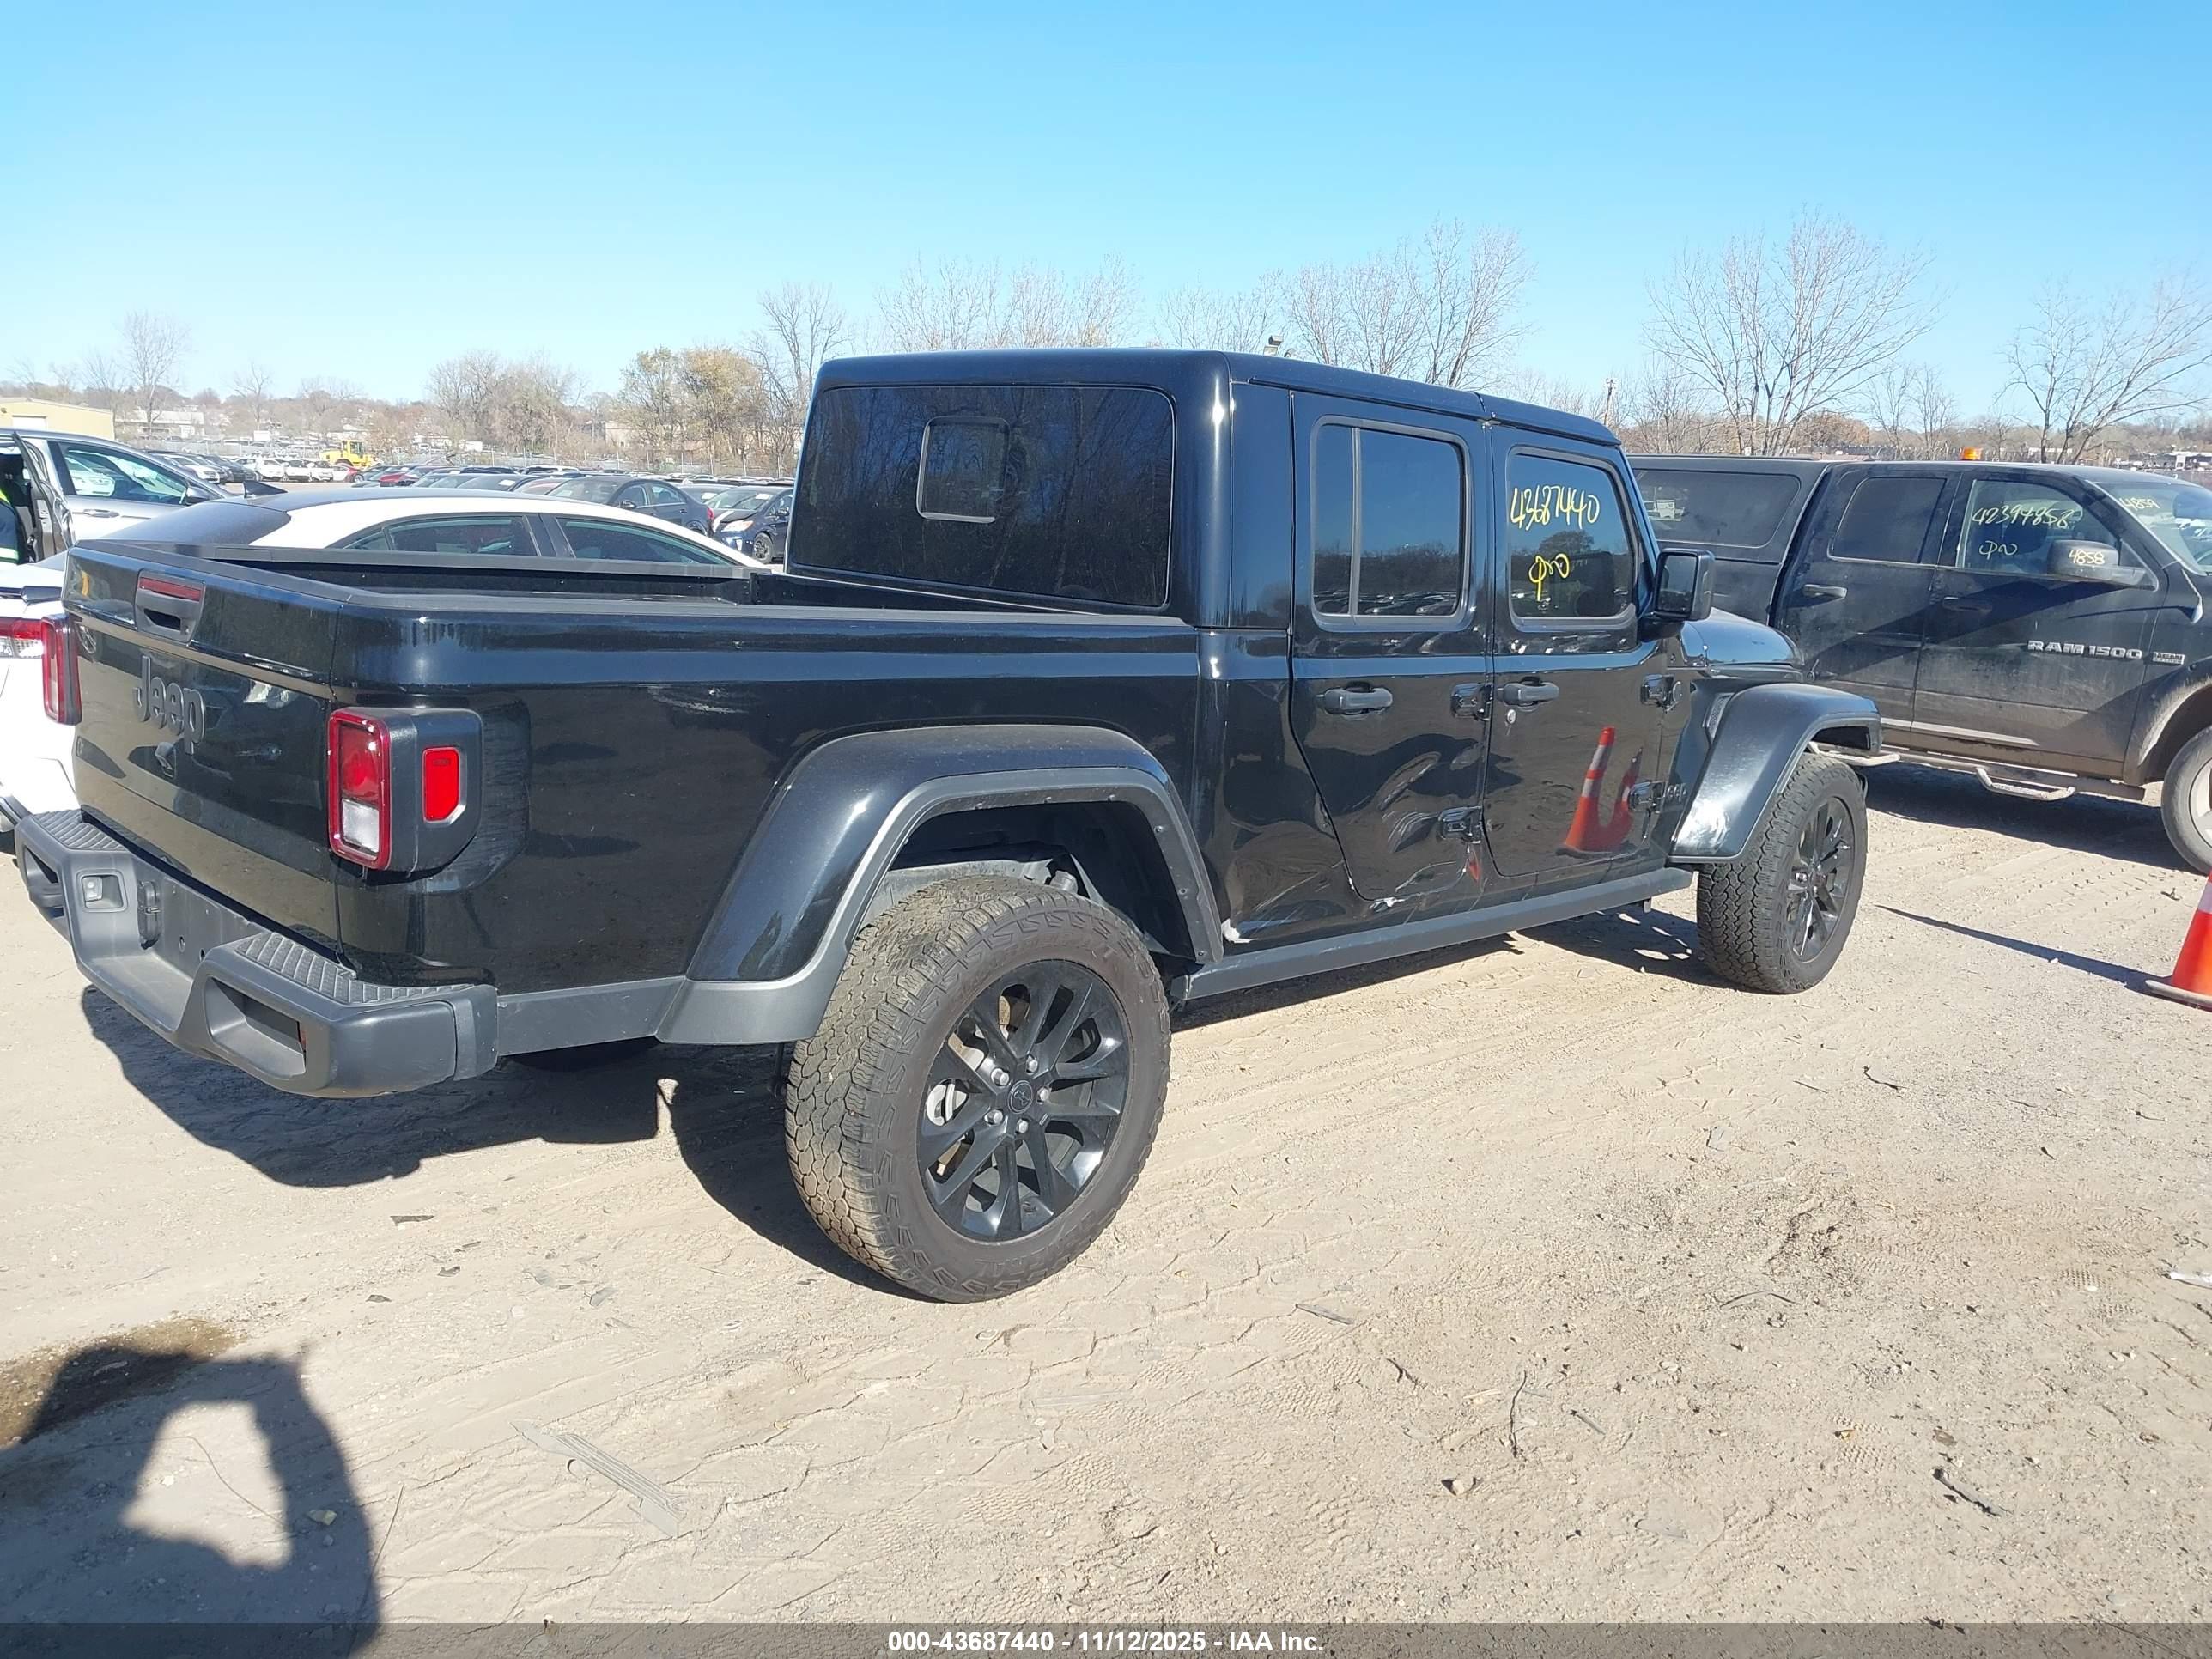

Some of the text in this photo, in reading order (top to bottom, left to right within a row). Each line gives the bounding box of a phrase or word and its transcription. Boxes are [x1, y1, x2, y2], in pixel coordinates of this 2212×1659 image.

[1510, 485, 1600, 530] 43687440
[1972, 505, 2075, 529] 42394858
[2069, 549, 2105, 565] 4858
[2027, 641, 2142, 659] RAM 1500
[132, 655, 205, 755] Jeep
